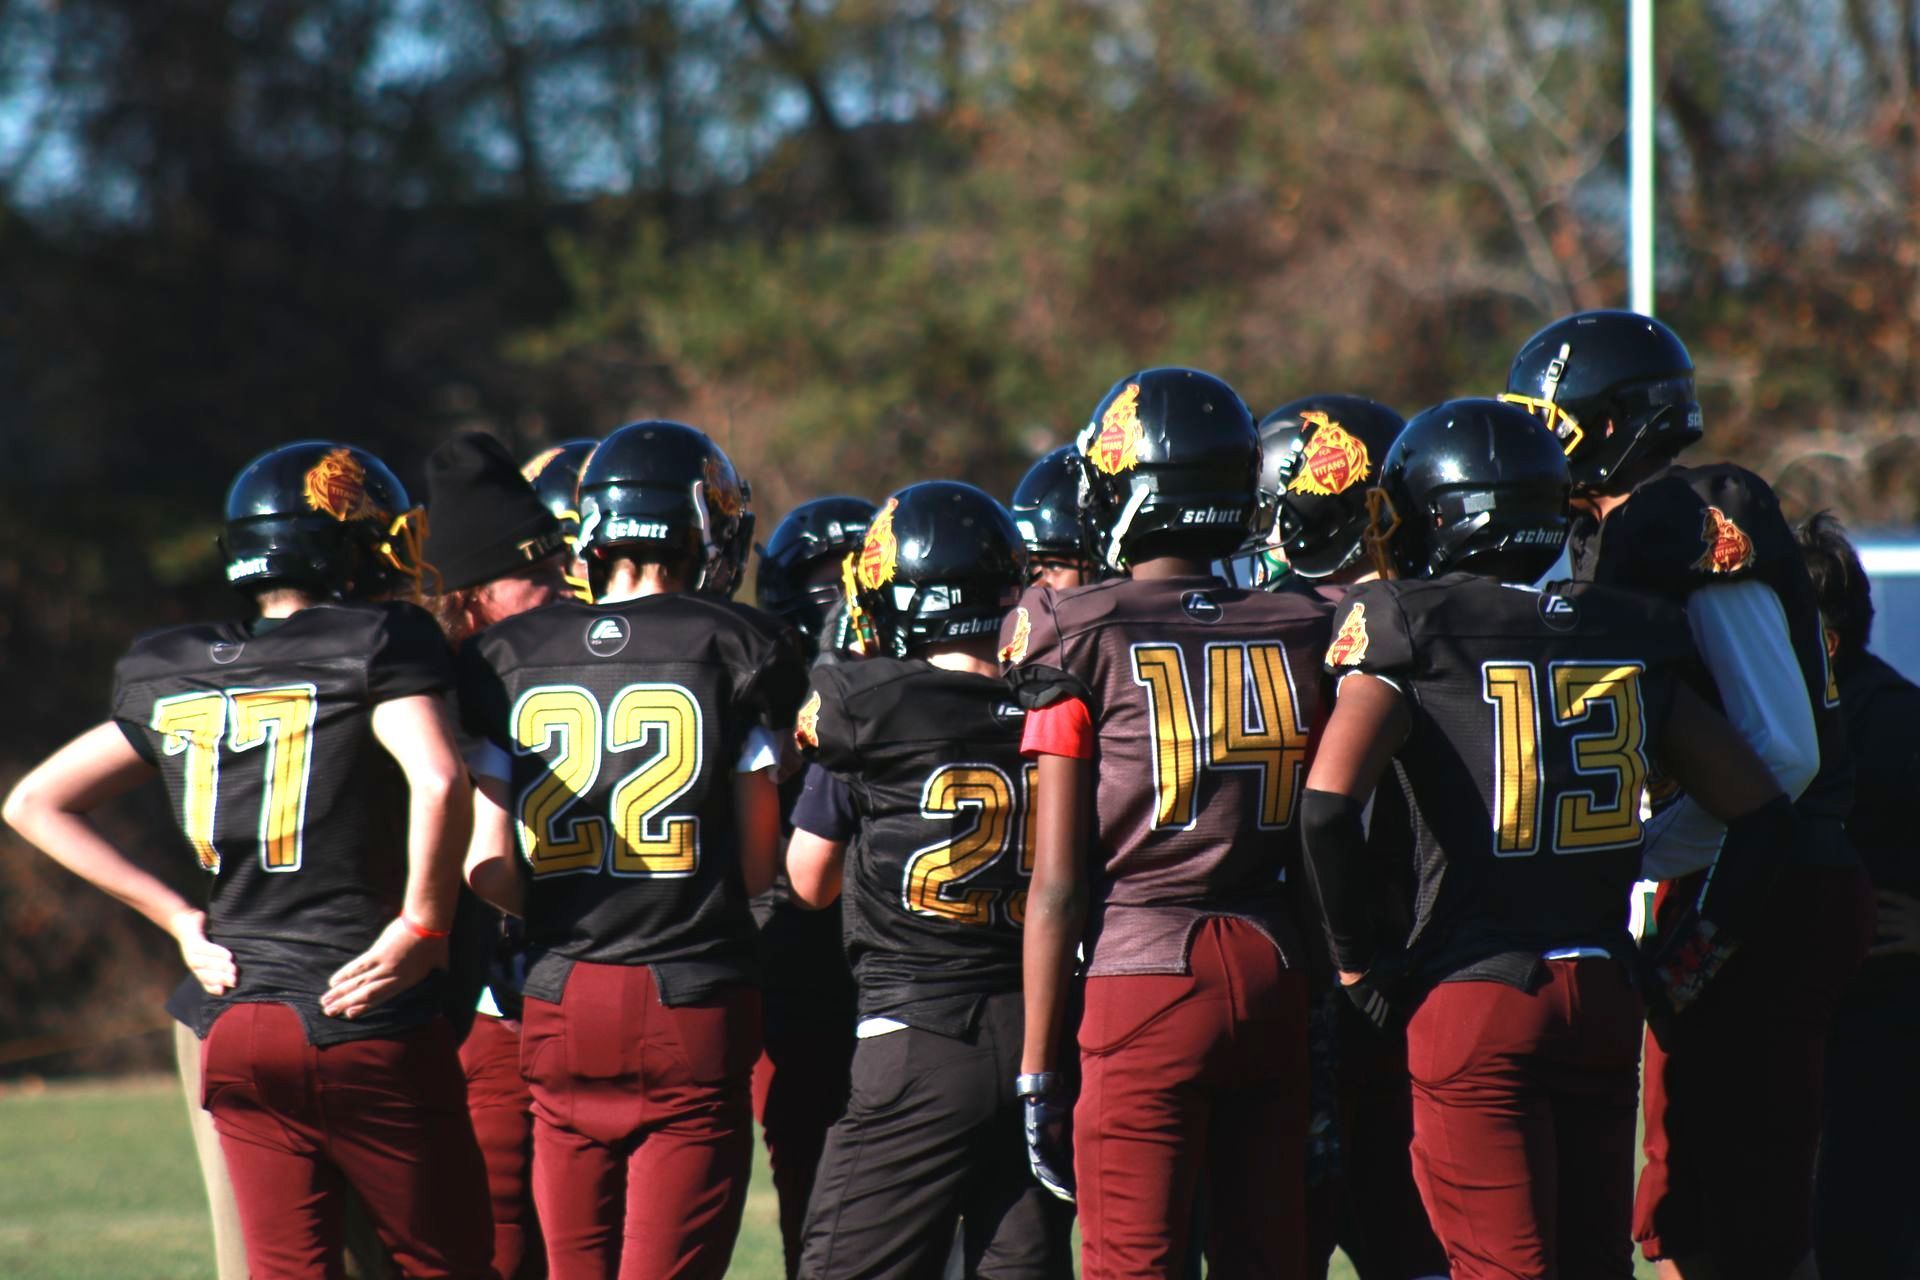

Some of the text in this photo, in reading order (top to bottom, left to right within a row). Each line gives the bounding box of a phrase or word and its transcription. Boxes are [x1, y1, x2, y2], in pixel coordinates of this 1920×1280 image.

[1183, 507, 1242, 523] schutt
[1314, 459, 1346, 477] TITANS
[1514, 528, 1564, 544] schutt
[151, 684, 318, 874] 77
[511, 683, 704, 878] 22
[1131, 641, 1308, 830] 14
[1482, 661, 1648, 857] 13
[902, 762, 1038, 928] 2
